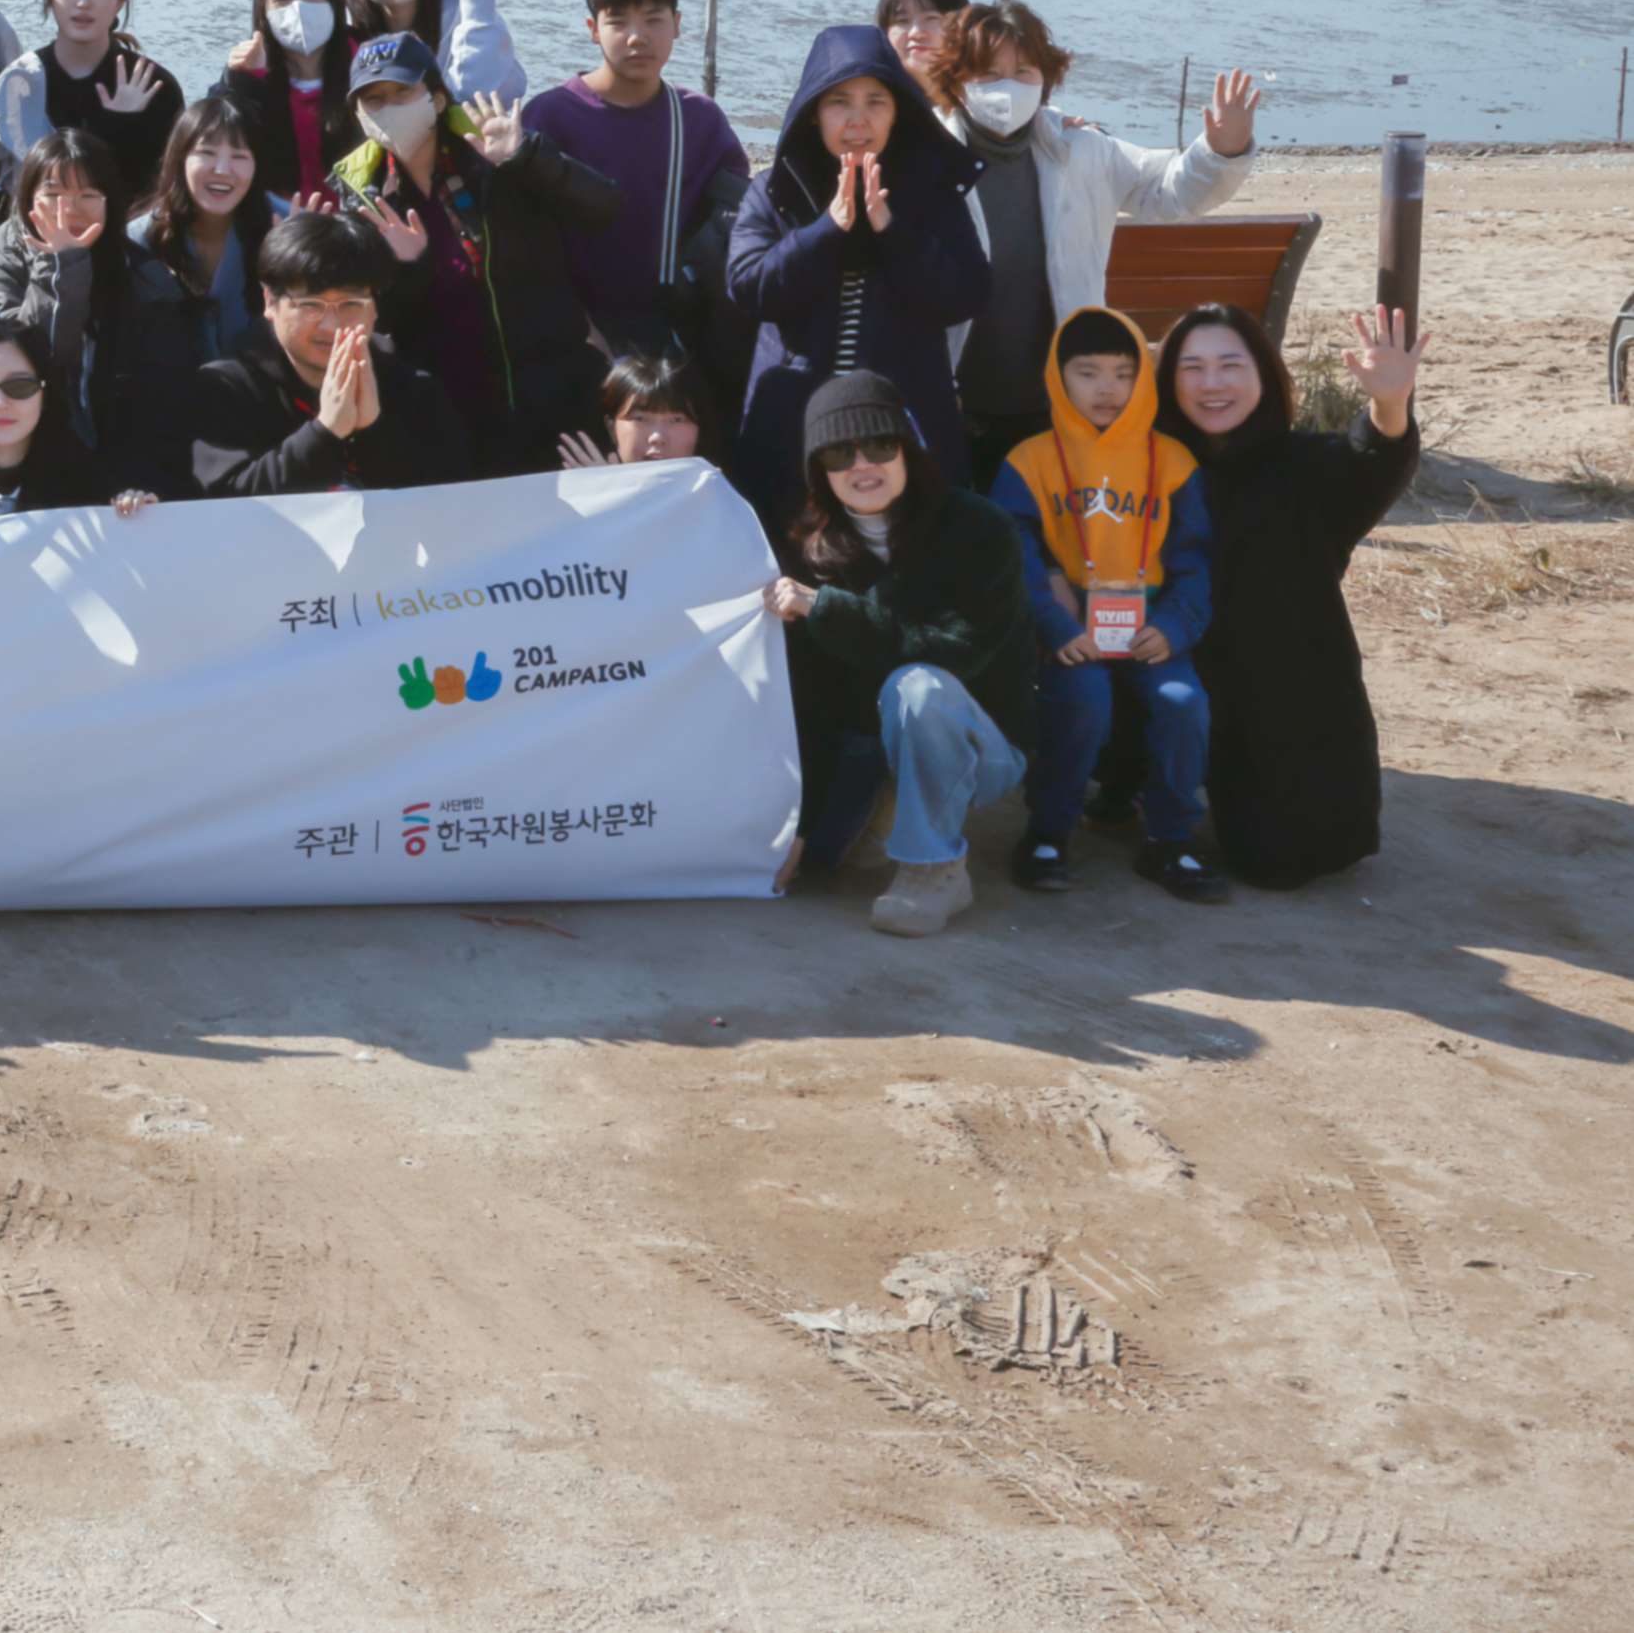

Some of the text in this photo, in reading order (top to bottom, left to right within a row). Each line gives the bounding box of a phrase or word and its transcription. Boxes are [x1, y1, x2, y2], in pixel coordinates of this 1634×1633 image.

[279, 595, 339, 634] 주최
[512, 644, 558, 669] 201
[513, 659, 647, 694] CAMPAIGN
[293, 822, 359, 859] 주관
[436, 800, 657, 853] 한국자원봉사문화
